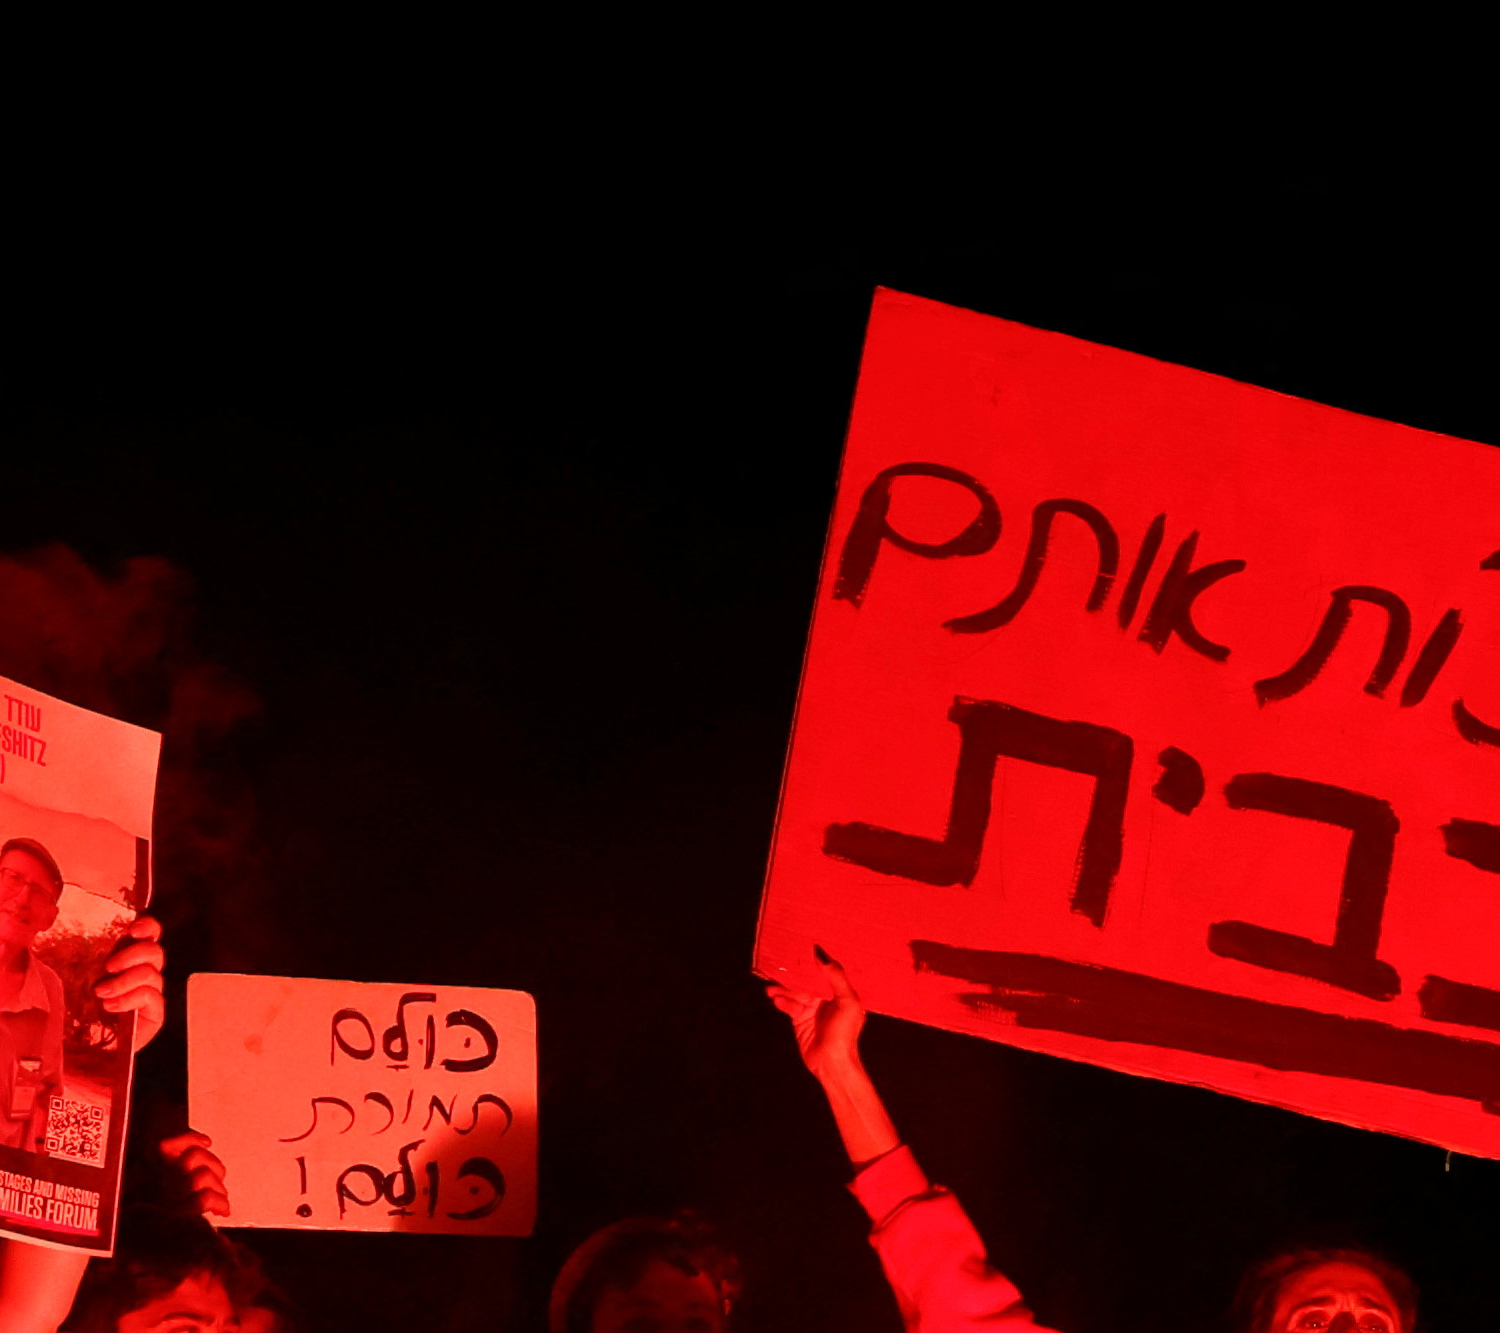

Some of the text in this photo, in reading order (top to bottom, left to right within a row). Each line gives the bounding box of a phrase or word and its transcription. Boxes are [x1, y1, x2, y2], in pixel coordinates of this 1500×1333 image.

[832, 460, 1247, 663] אותם
[4, 693, 42, 732] עודד
[331, 992, 499, 1072] כולם
[33, 1179, 54, 1198] AND
[54, 1183, 101, 1208] MISSING
[45, 1199, 99, 1231] FORUM
